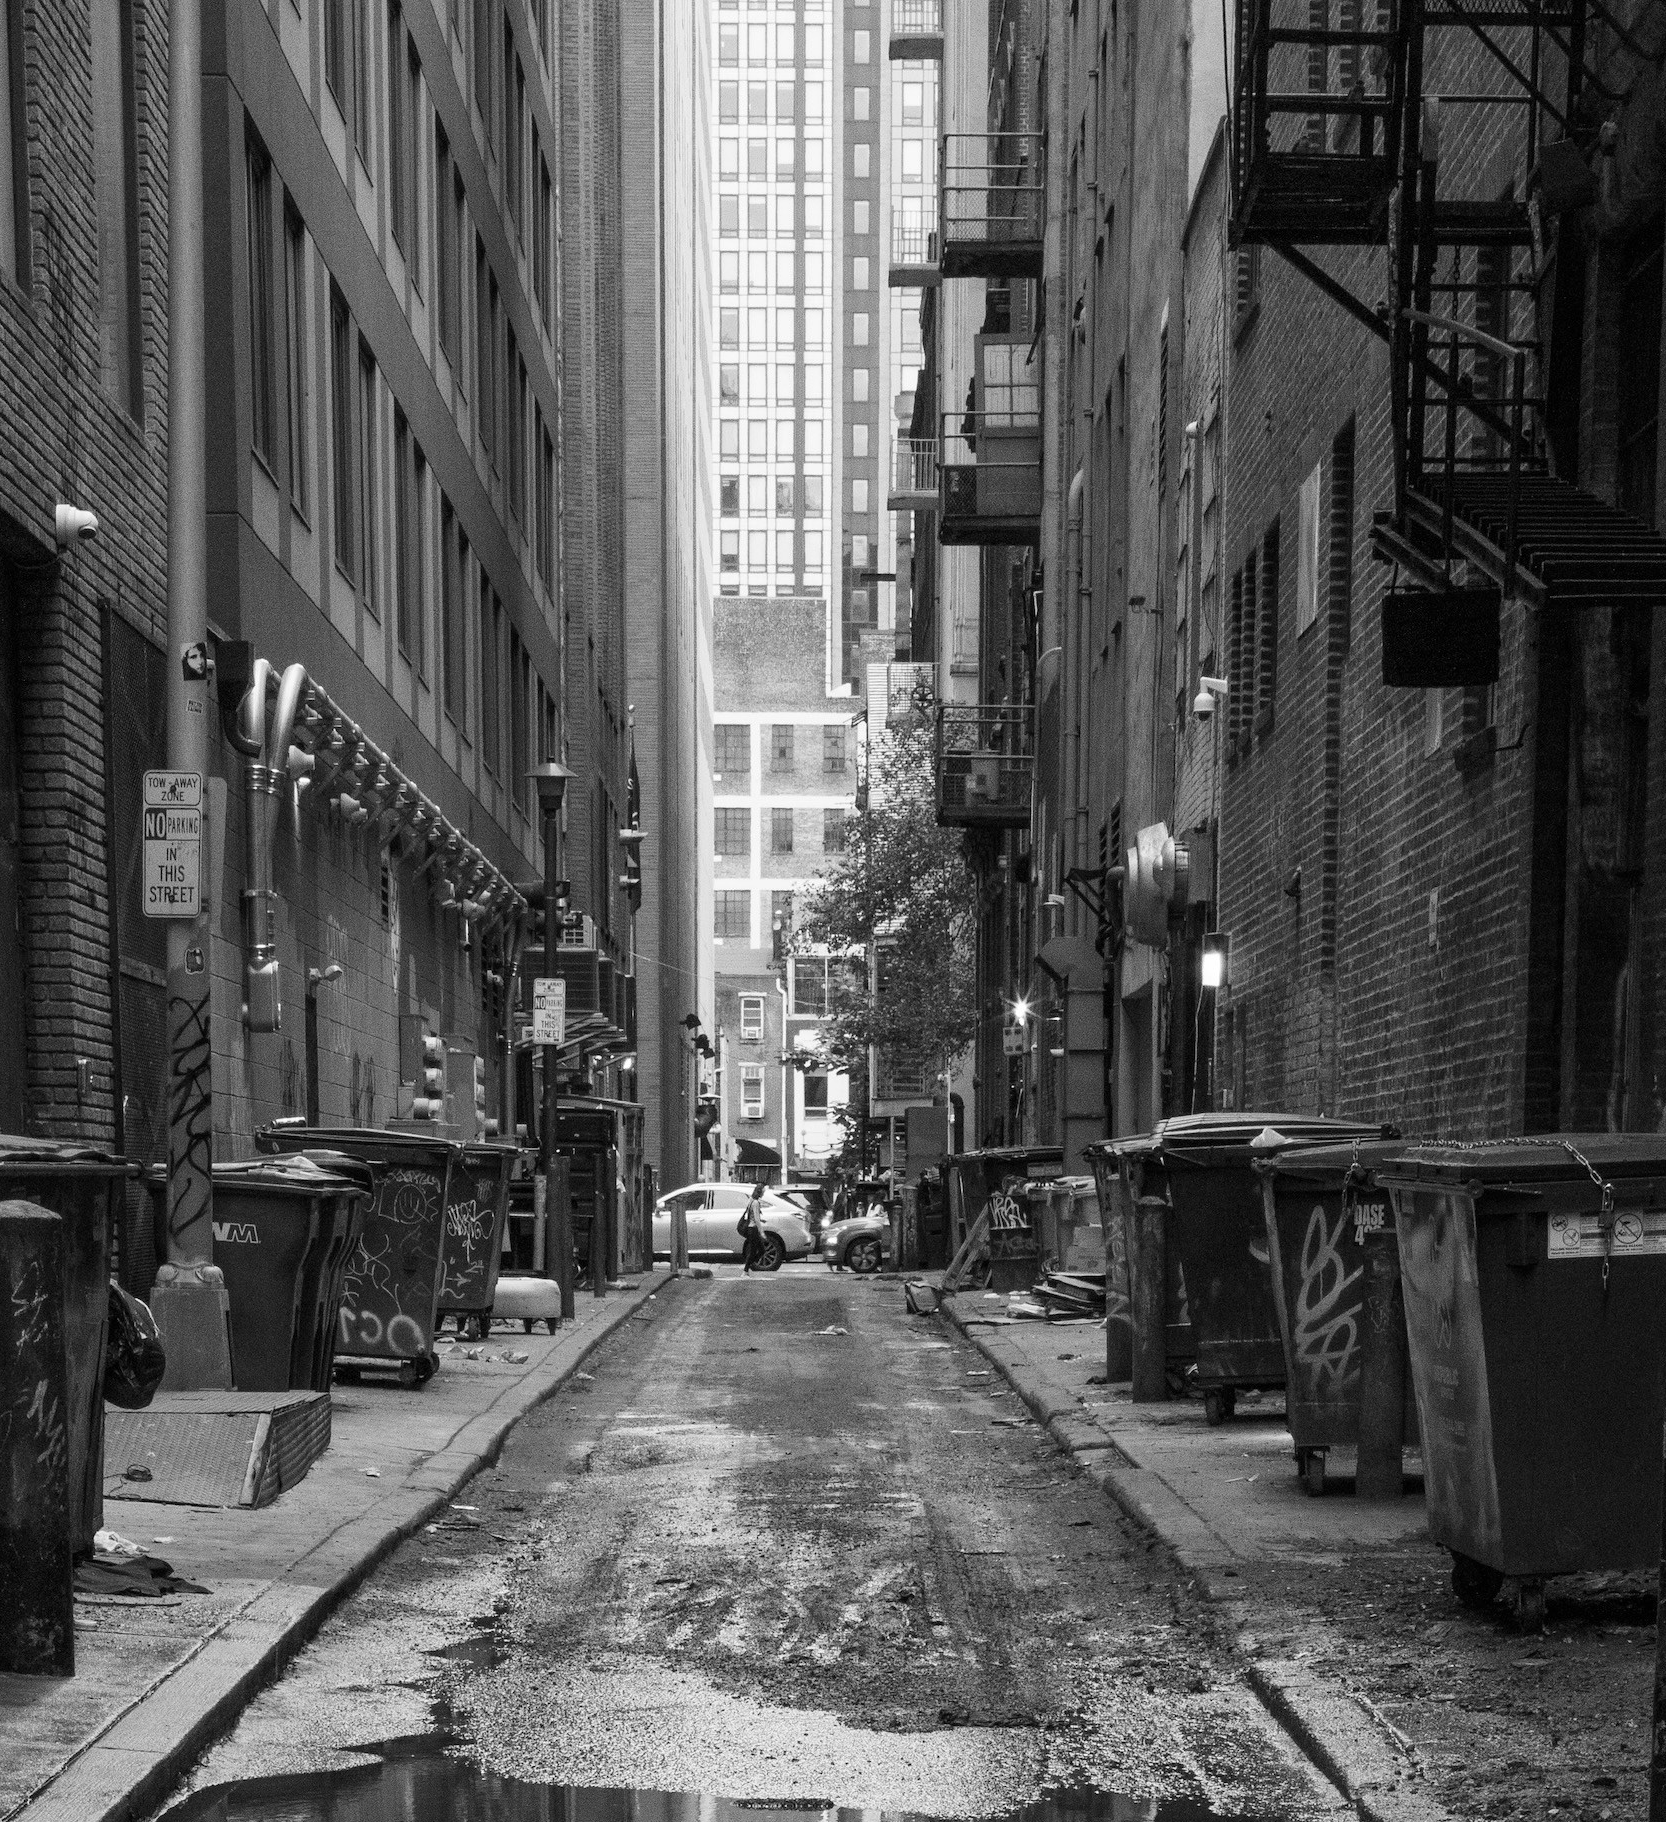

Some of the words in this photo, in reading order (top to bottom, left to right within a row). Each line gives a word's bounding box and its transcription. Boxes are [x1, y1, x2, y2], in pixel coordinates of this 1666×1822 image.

[161, 792, 185, 801] ZONE
[146, 812, 166, 838] NO
[167, 817, 199, 834] PARKING
[166, 848, 177, 861] IN
[158, 865, 185, 882] THIS
[149, 886, 195, 903] STREET
[535, 997, 546, 1009] NO
